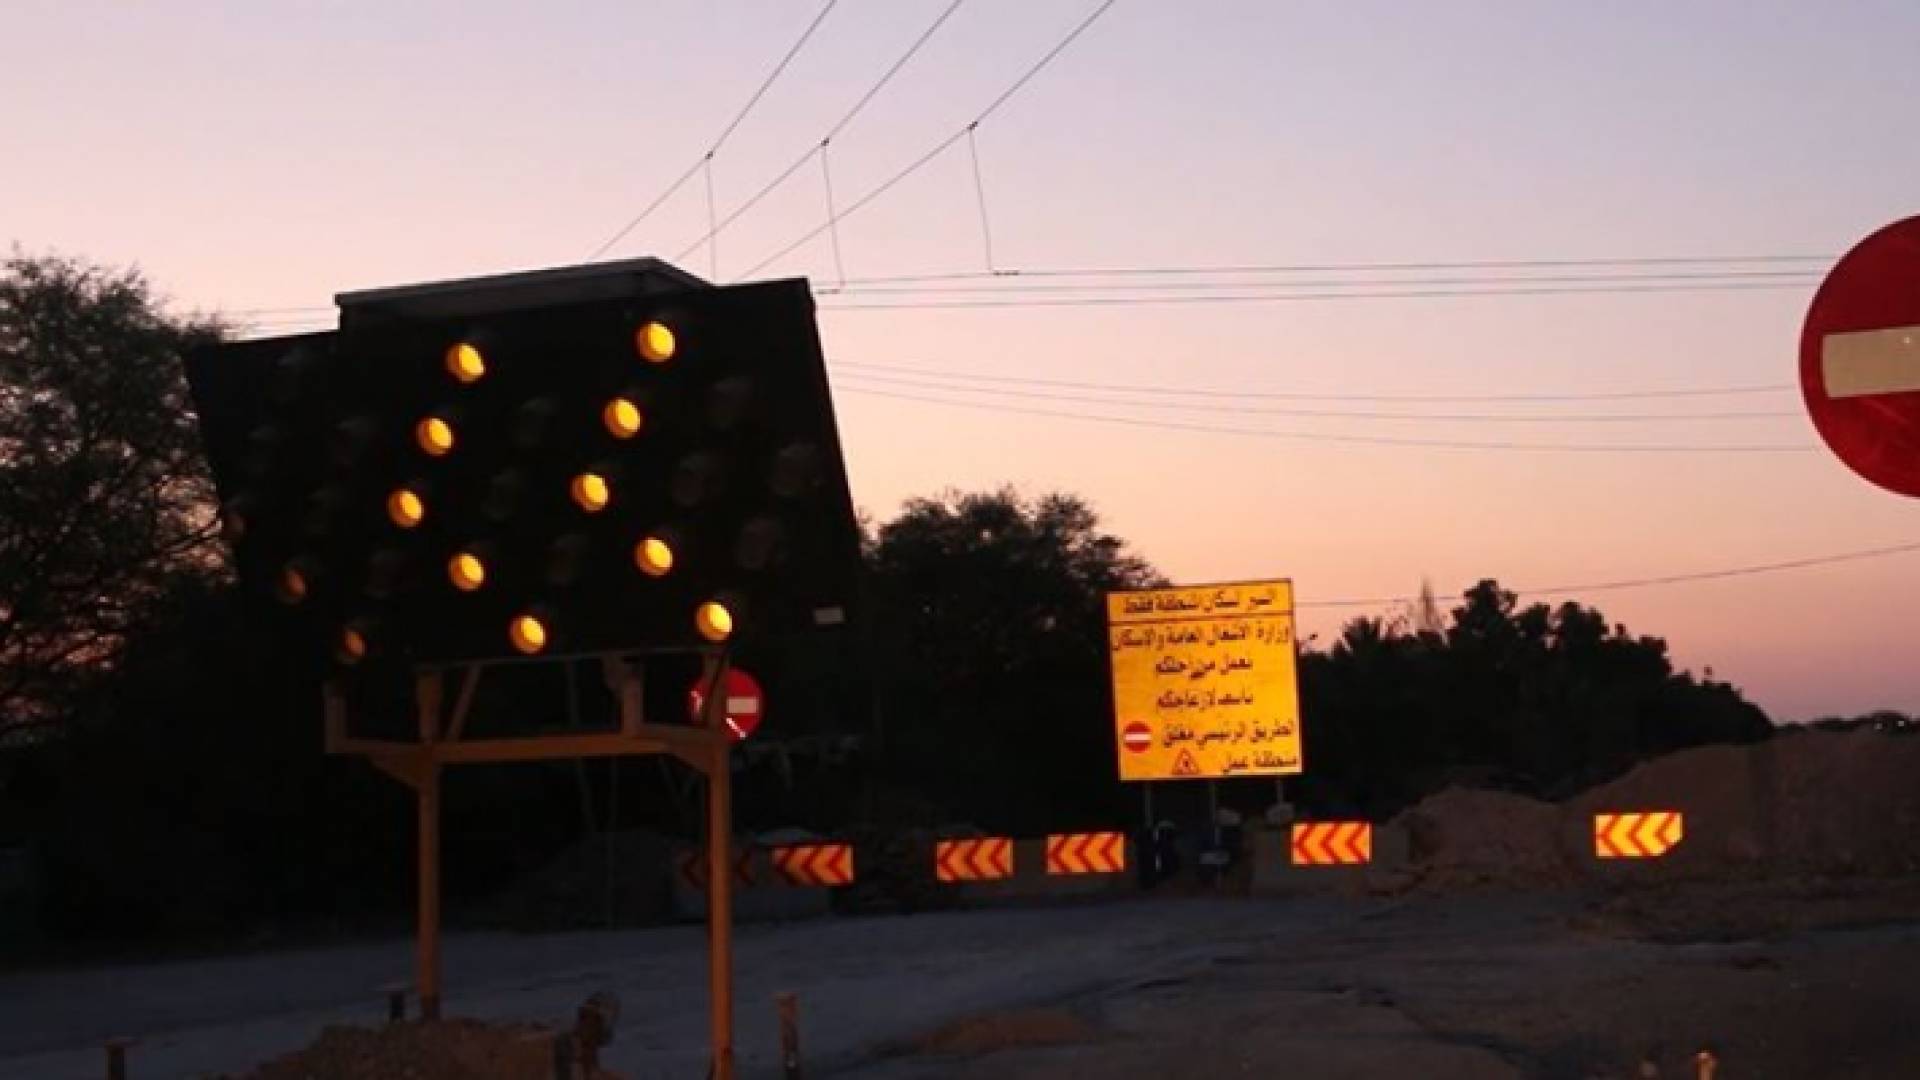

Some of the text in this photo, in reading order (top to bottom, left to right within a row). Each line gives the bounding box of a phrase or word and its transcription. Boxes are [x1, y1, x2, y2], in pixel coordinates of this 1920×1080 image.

[1123, 594, 1154, 614] فقط
[1256, 620, 1290, 646] وزارة
[1250, 718, 1294, 744] الطريق
